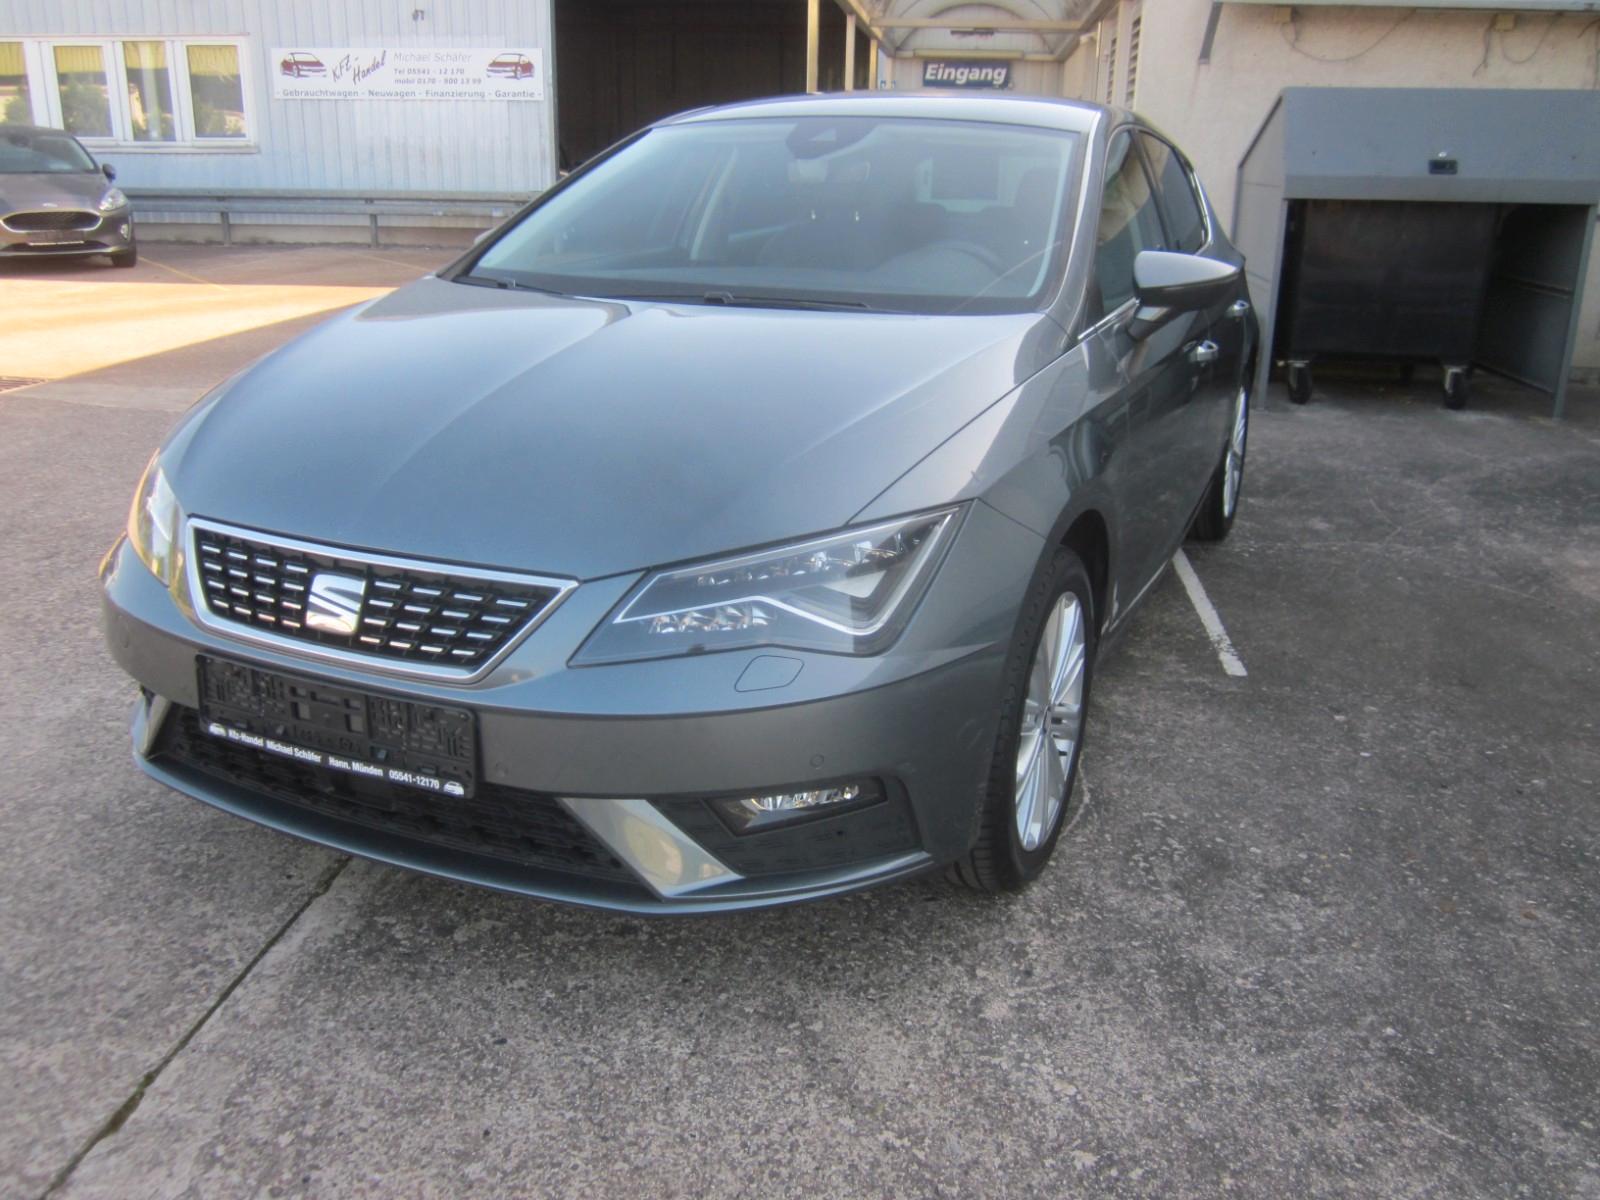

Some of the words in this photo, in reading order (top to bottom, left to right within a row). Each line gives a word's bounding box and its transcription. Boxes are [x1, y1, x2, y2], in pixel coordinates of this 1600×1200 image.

[352, 49, 386, 86] Handel
[394, 52, 430, 63] Michael
[925, 63, 1007, 84] Eingang
[282, 88, 359, 98] Gebrauchtwagen
[368, 89, 416, 98] Neuwagen
[425, 89, 486, 98] Finanzierung
[495, 89, 535, 98] Garantie
[266, 740, 294, 757] Michael
[328, 755, 351, 771] Hann.
[352, 761, 384, 777] Münden
[388, 769, 440, 790] 05541-12170
